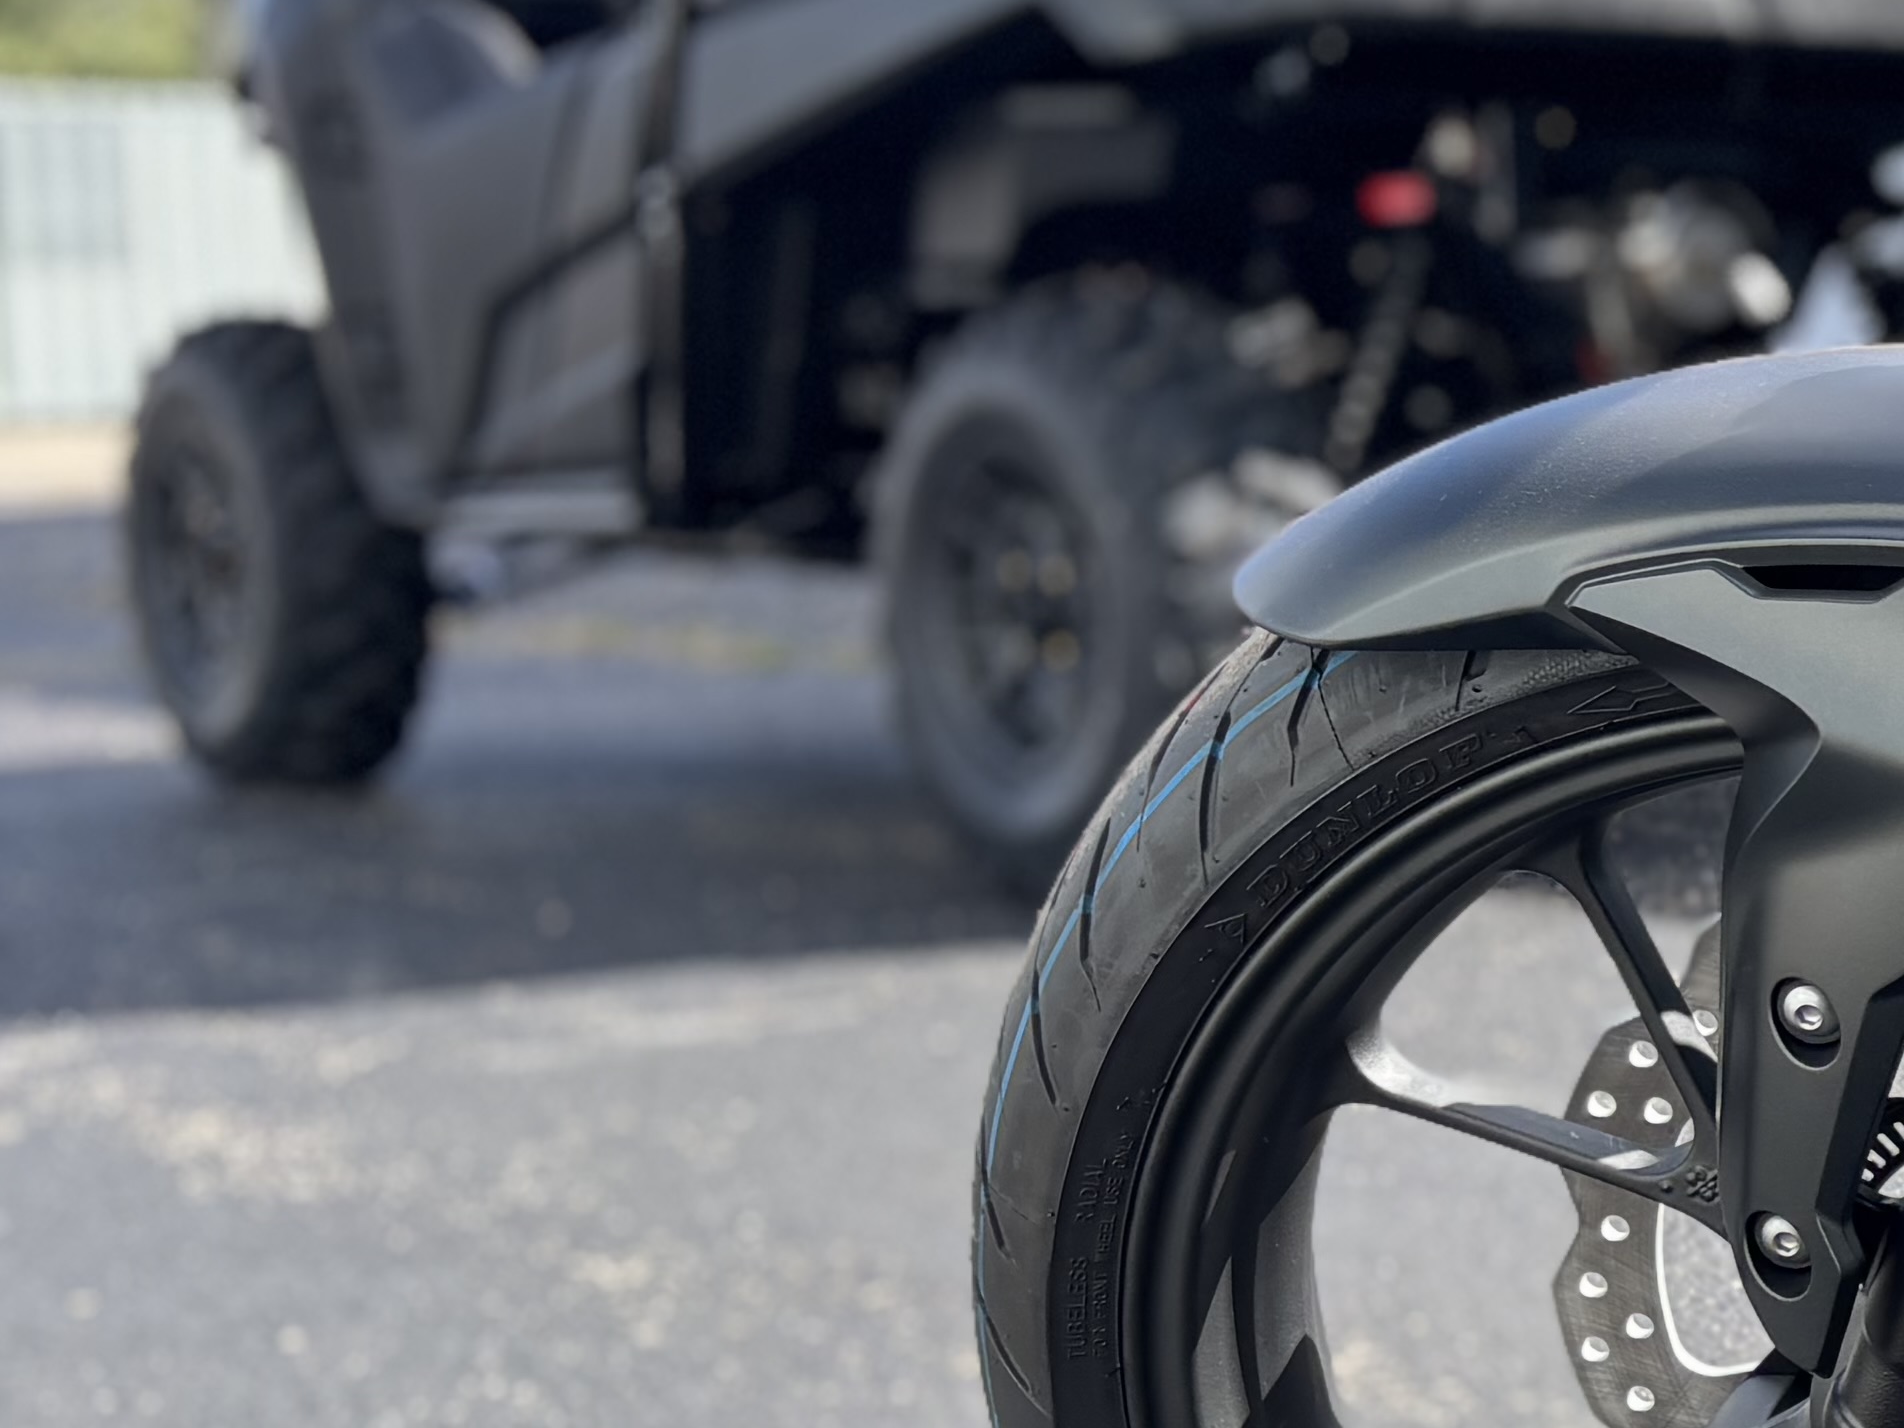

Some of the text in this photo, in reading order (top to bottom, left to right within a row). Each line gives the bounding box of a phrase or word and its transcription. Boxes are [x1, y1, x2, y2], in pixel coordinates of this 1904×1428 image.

[1103, 1175, 1126, 1206] USE
[1067, 1157, 1109, 1360] TUBELESS RADIAL
